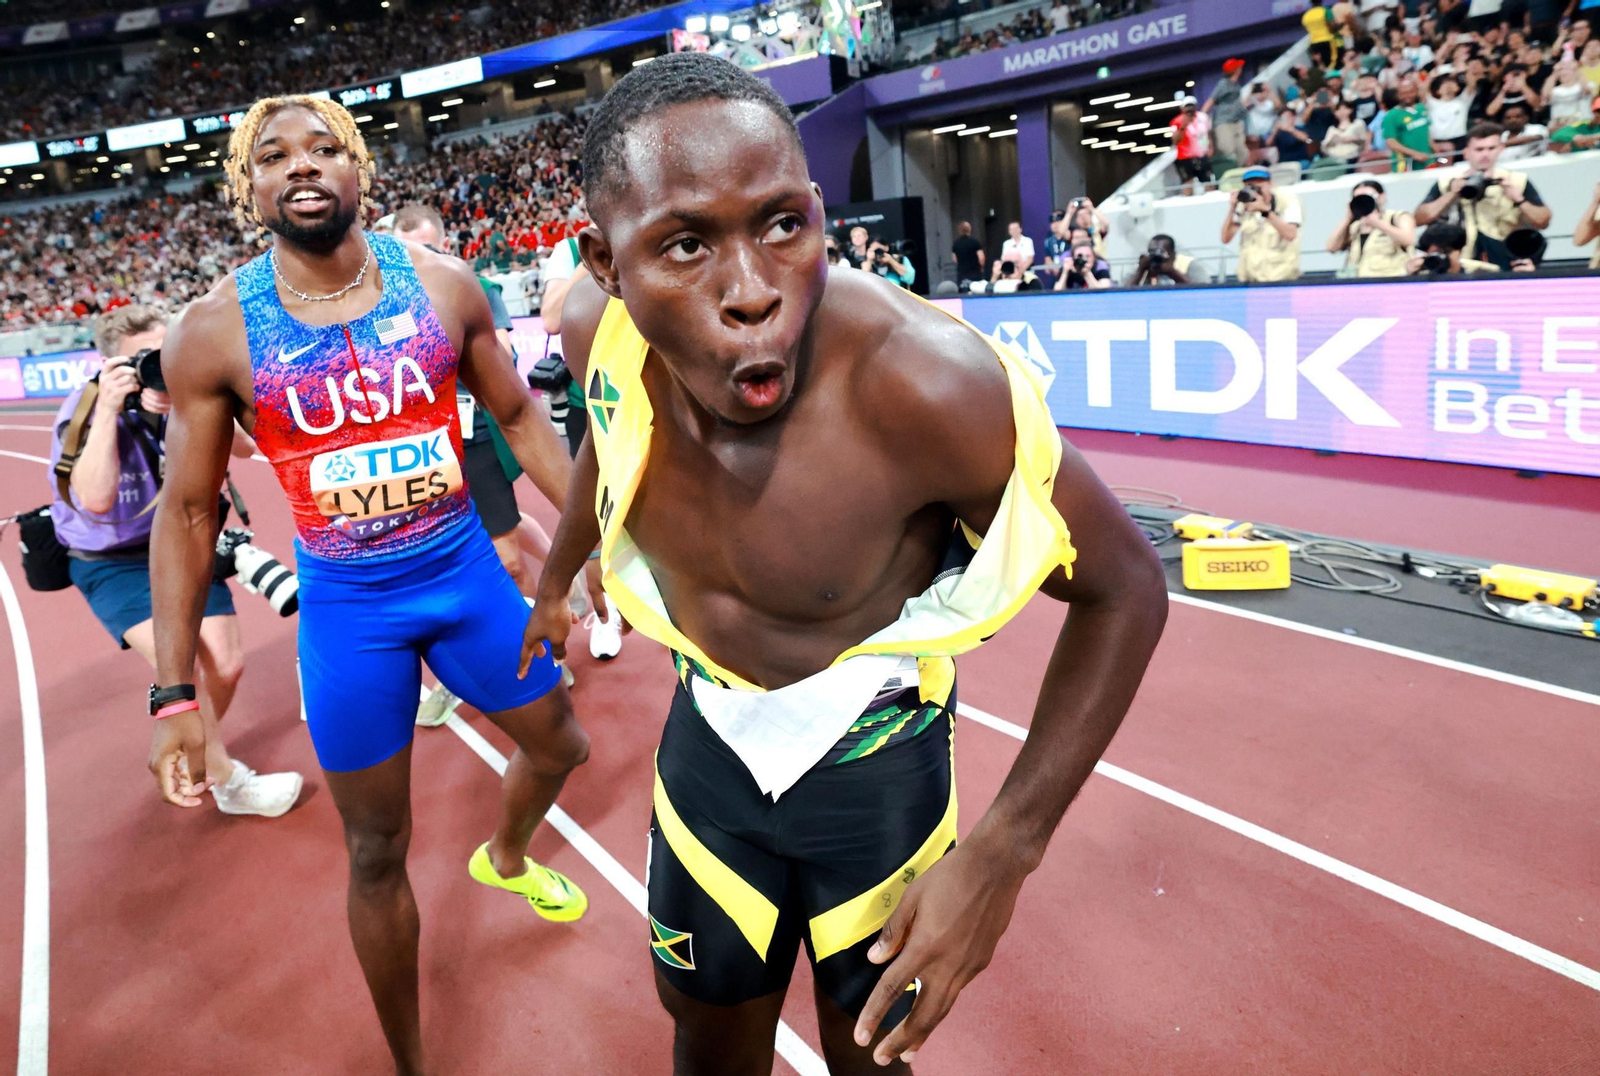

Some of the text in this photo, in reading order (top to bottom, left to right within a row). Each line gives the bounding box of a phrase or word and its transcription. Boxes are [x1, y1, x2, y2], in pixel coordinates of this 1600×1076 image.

[1003, 14, 1188, 73] MARATHON GATE
[1435, 316, 1511, 372] In
[36, 360, 94, 390] TDK
[285, 356, 436, 436] USA
[1051, 318, 1402, 428] TDK
[1433, 379, 1600, 445] Bet
[354, 434, 444, 477] TDK
[333, 471, 449, 518] LYLES
[1207, 560, 1270, 573] SEIKO
